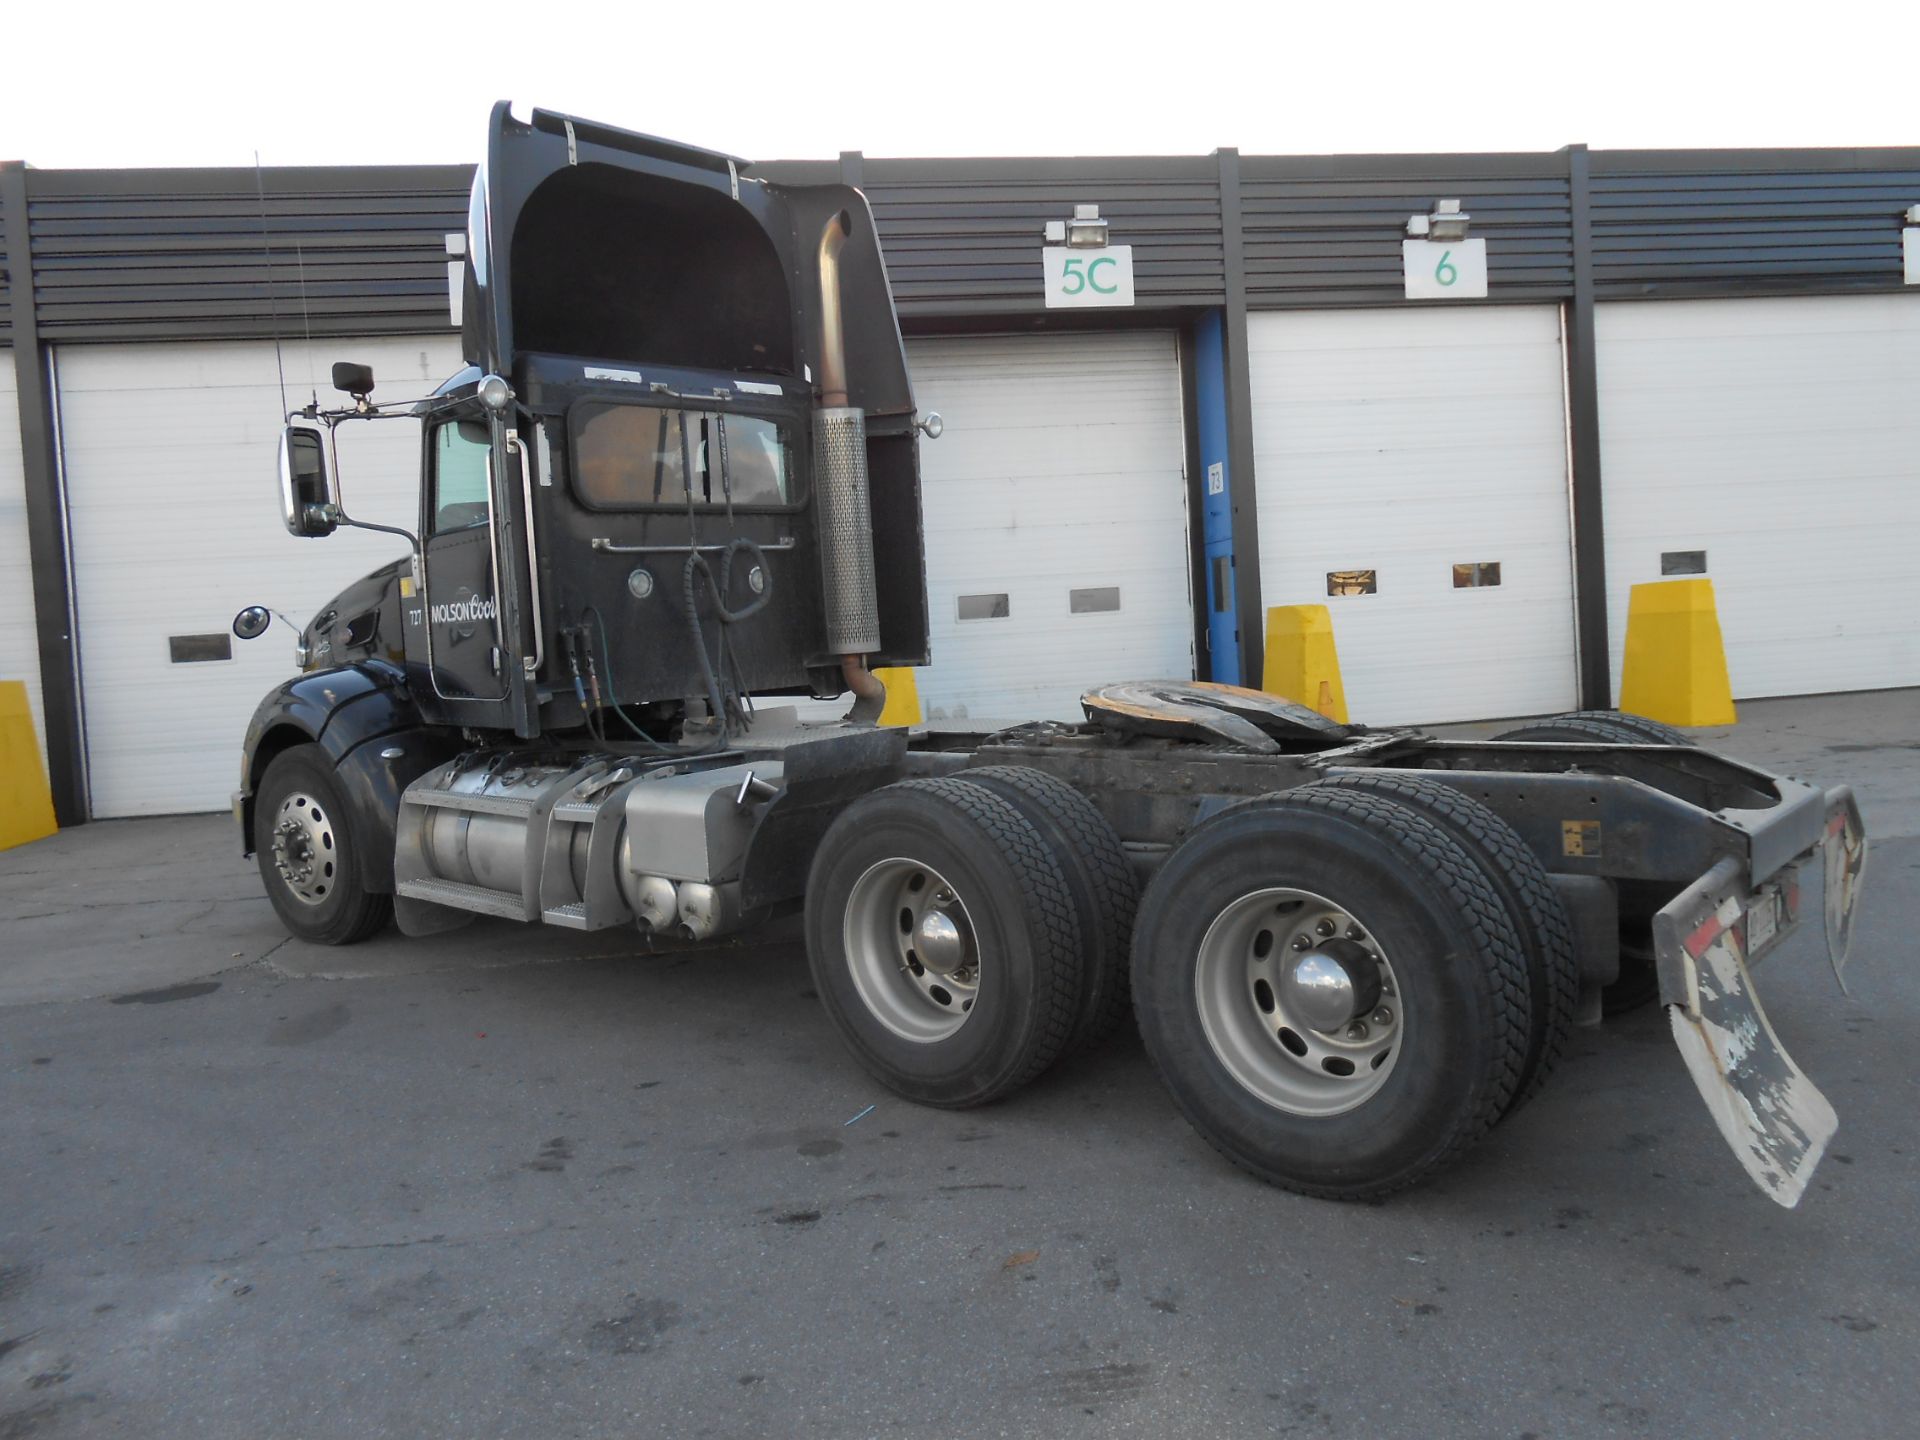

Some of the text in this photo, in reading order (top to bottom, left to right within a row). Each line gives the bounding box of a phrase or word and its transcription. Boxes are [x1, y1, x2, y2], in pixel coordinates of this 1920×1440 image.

[1062, 257, 1117, 295] 5C
[1435, 250, 1457, 287] 6
[409, 609, 422, 626] 727
[431, 594, 497, 623] MOLSON Coor
